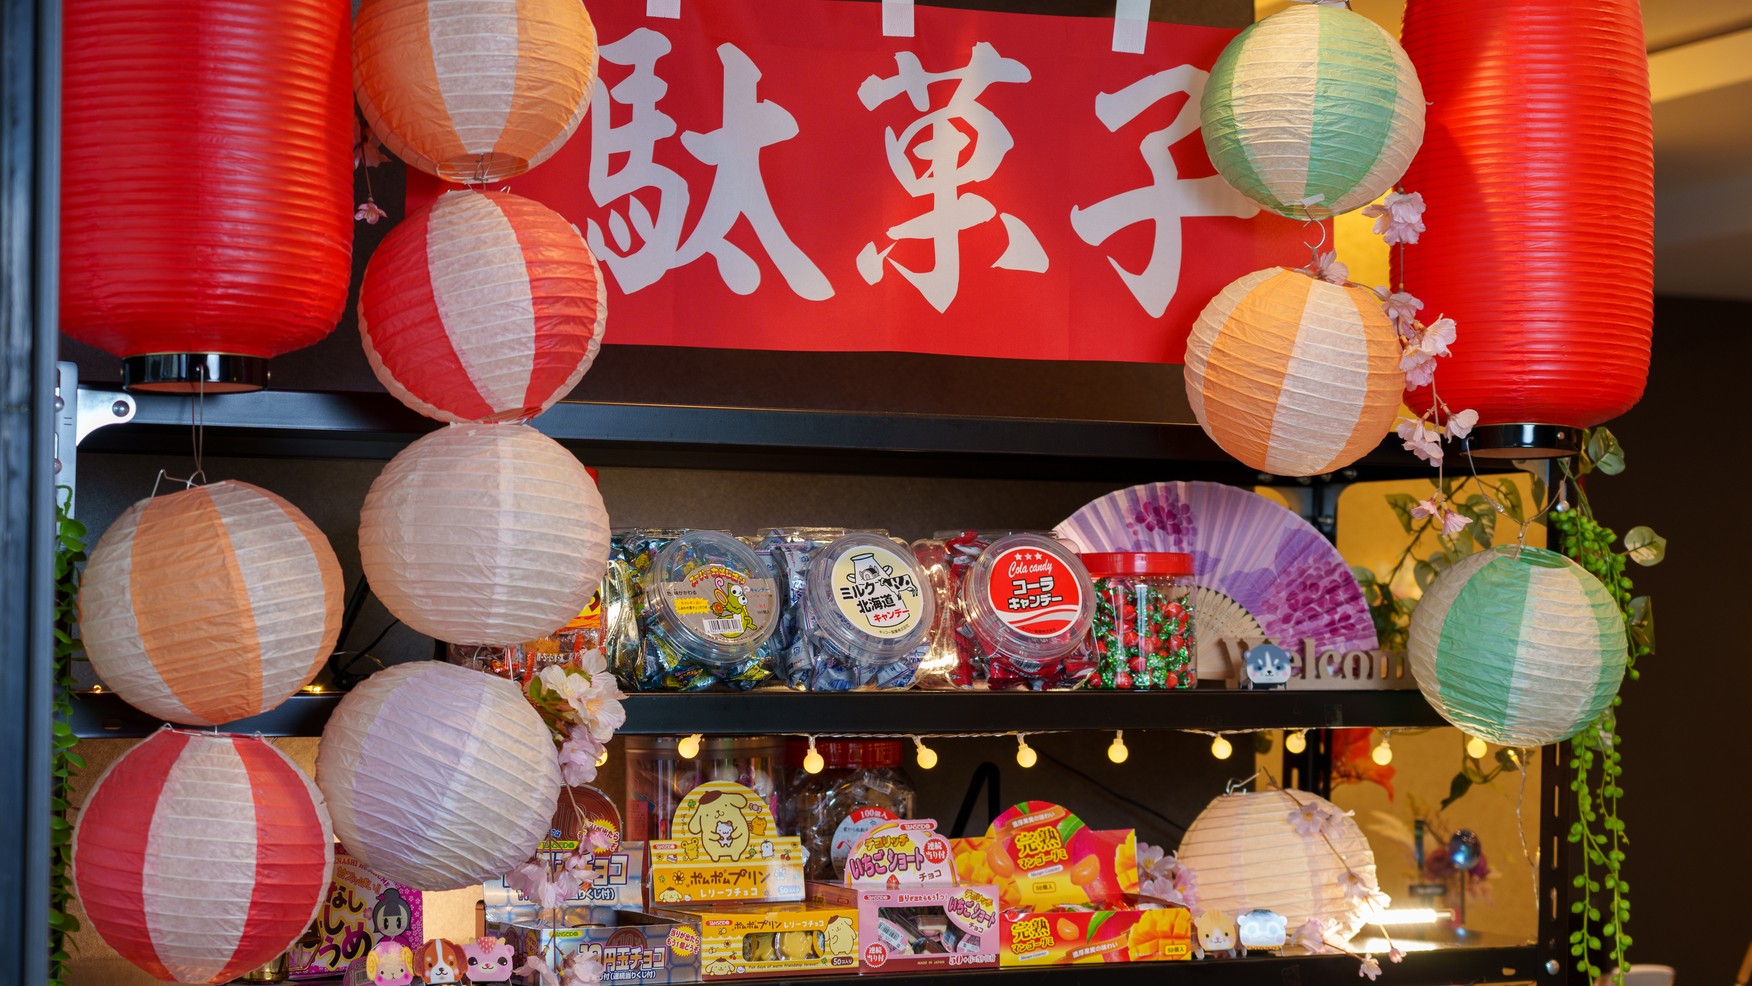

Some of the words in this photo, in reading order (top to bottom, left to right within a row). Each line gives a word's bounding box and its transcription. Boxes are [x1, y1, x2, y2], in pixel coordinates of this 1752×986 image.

[580, 27, 1258, 318] 駄菓子
[1008, 561, 1028, 578] Cola
[1029, 559, 1053, 575] candy
[840, 582, 875, 600] ミルク
[1012, 576, 1054, 595] コーラ
[857, 594, 896, 614] 北海道
[1008, 593, 1063, 610] キャンデー
[873, 608, 909, 622] キャンデー
[1216, 637, 1411, 681] Welcom
[860, 808, 889, 820] 100個入
[1015, 826, 1061, 857] 完熟
[849, 847, 925, 880] いちごショート
[1017, 848, 1068, 870] マンゴーグミ
[690, 868, 770, 885] ポムポムプリン
[918, 869, 942, 882] チョコ
[700, 887, 758, 898] レリーフチョコ
[948, 896, 997, 928] いちごショート
[734, 919, 782, 930] ポムポムプリン
[783, 920, 825, 928] レリーフチョコ
[968, 922, 984, 934] チョコ
[1011, 916, 1050, 943] 完熟
[670, 928, 700, 945] 当りが出たら
[1011, 936, 1054, 954] マンゴーグミ
